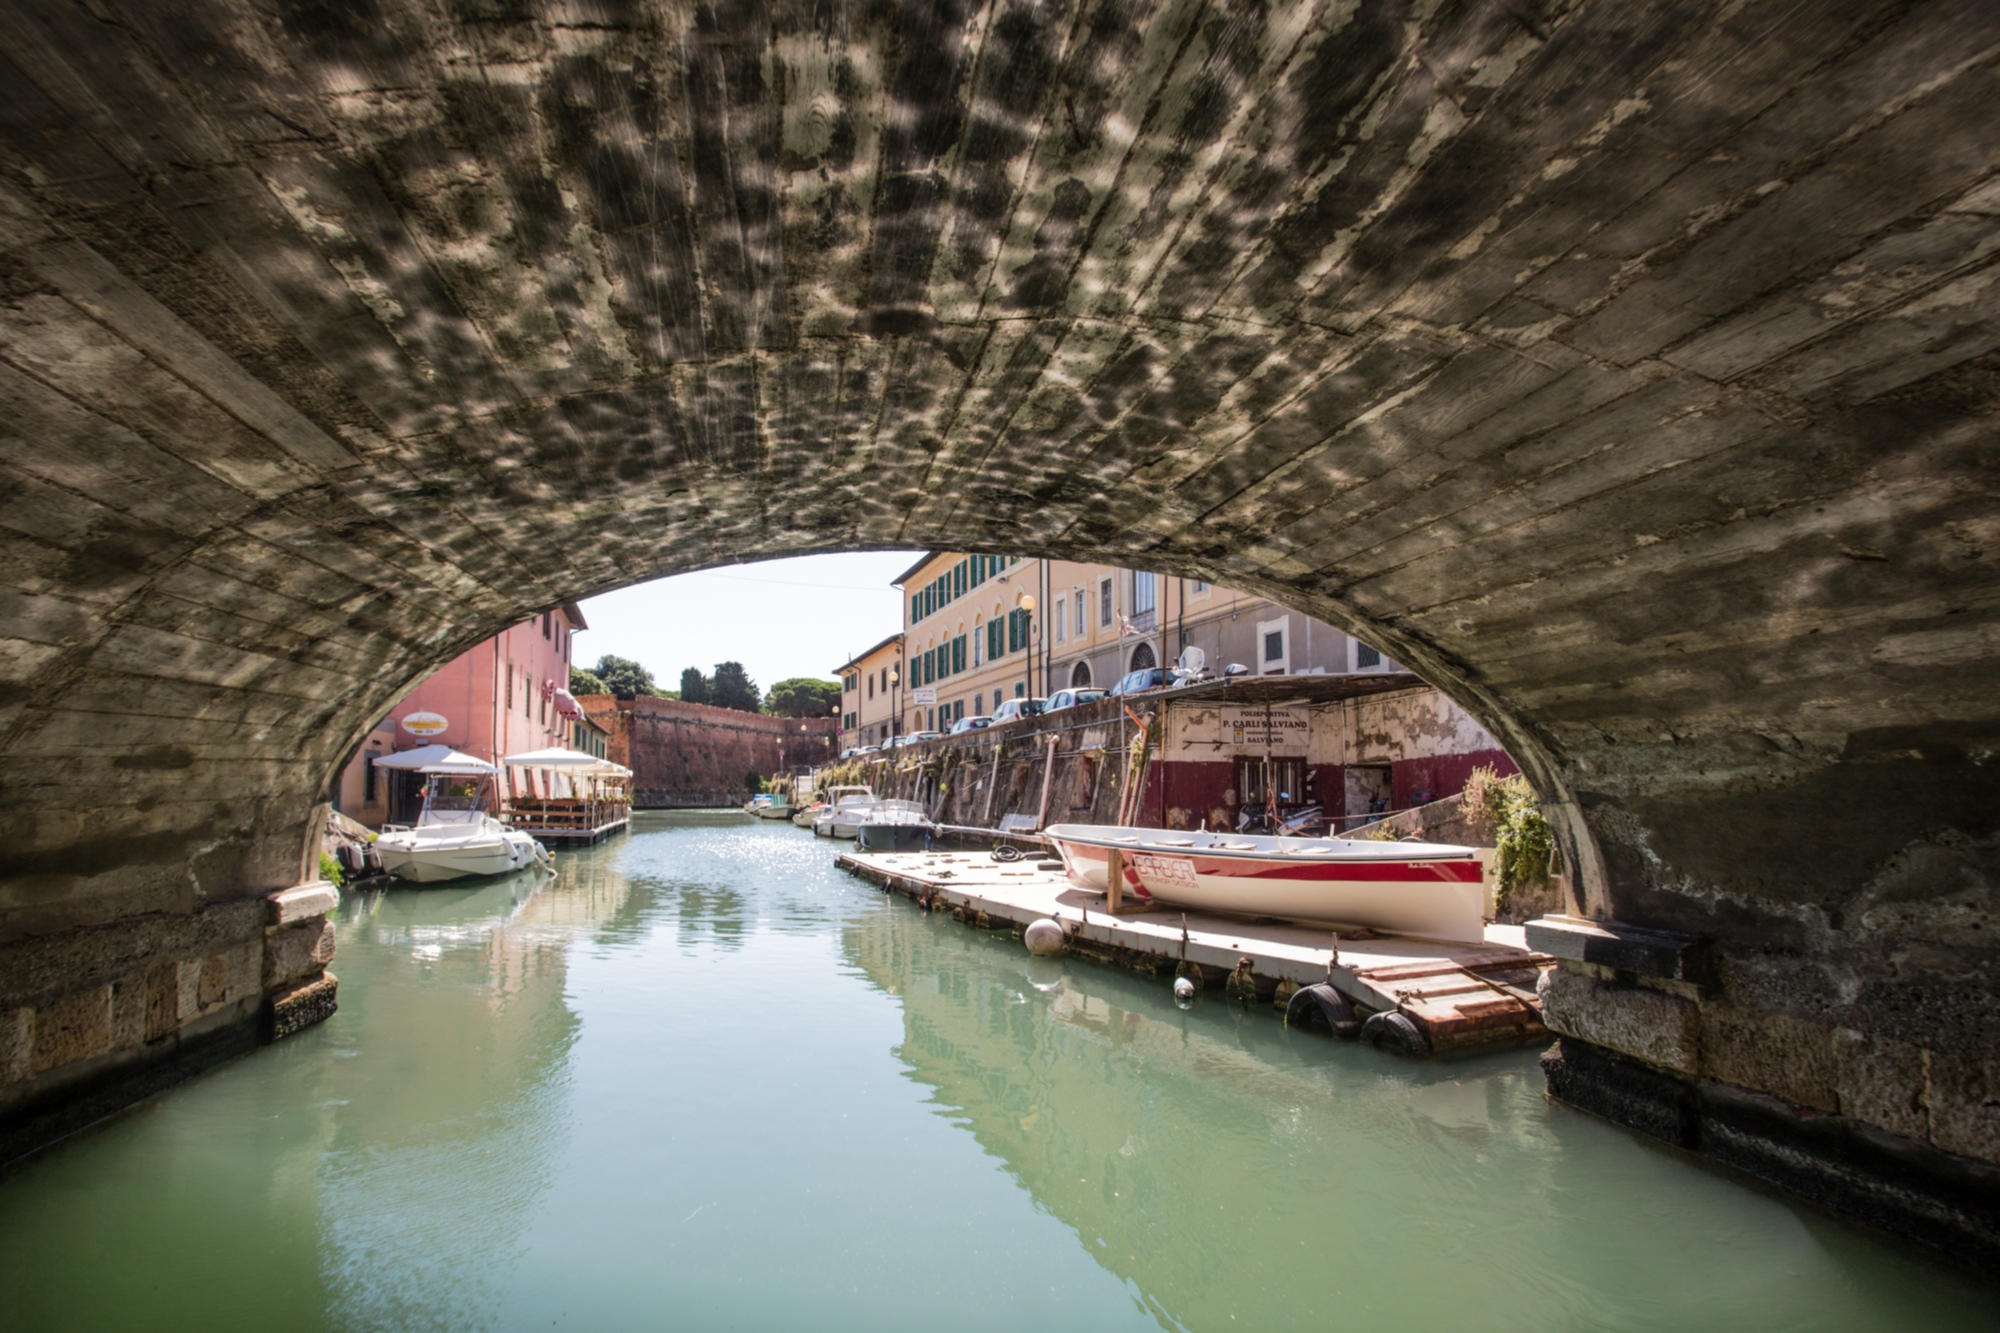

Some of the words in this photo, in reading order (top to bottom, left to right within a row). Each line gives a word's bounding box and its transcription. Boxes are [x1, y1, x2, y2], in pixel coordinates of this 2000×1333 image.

[1232, 720, 1260, 728] CARLI
[1261, 720, 1307, 728] SALVIANO
[1134, 855, 1196, 881] BARBIERI
[1142, 876, 1171, 885] INTERIOR
[1172, 879, 1199, 889] DESIGN
